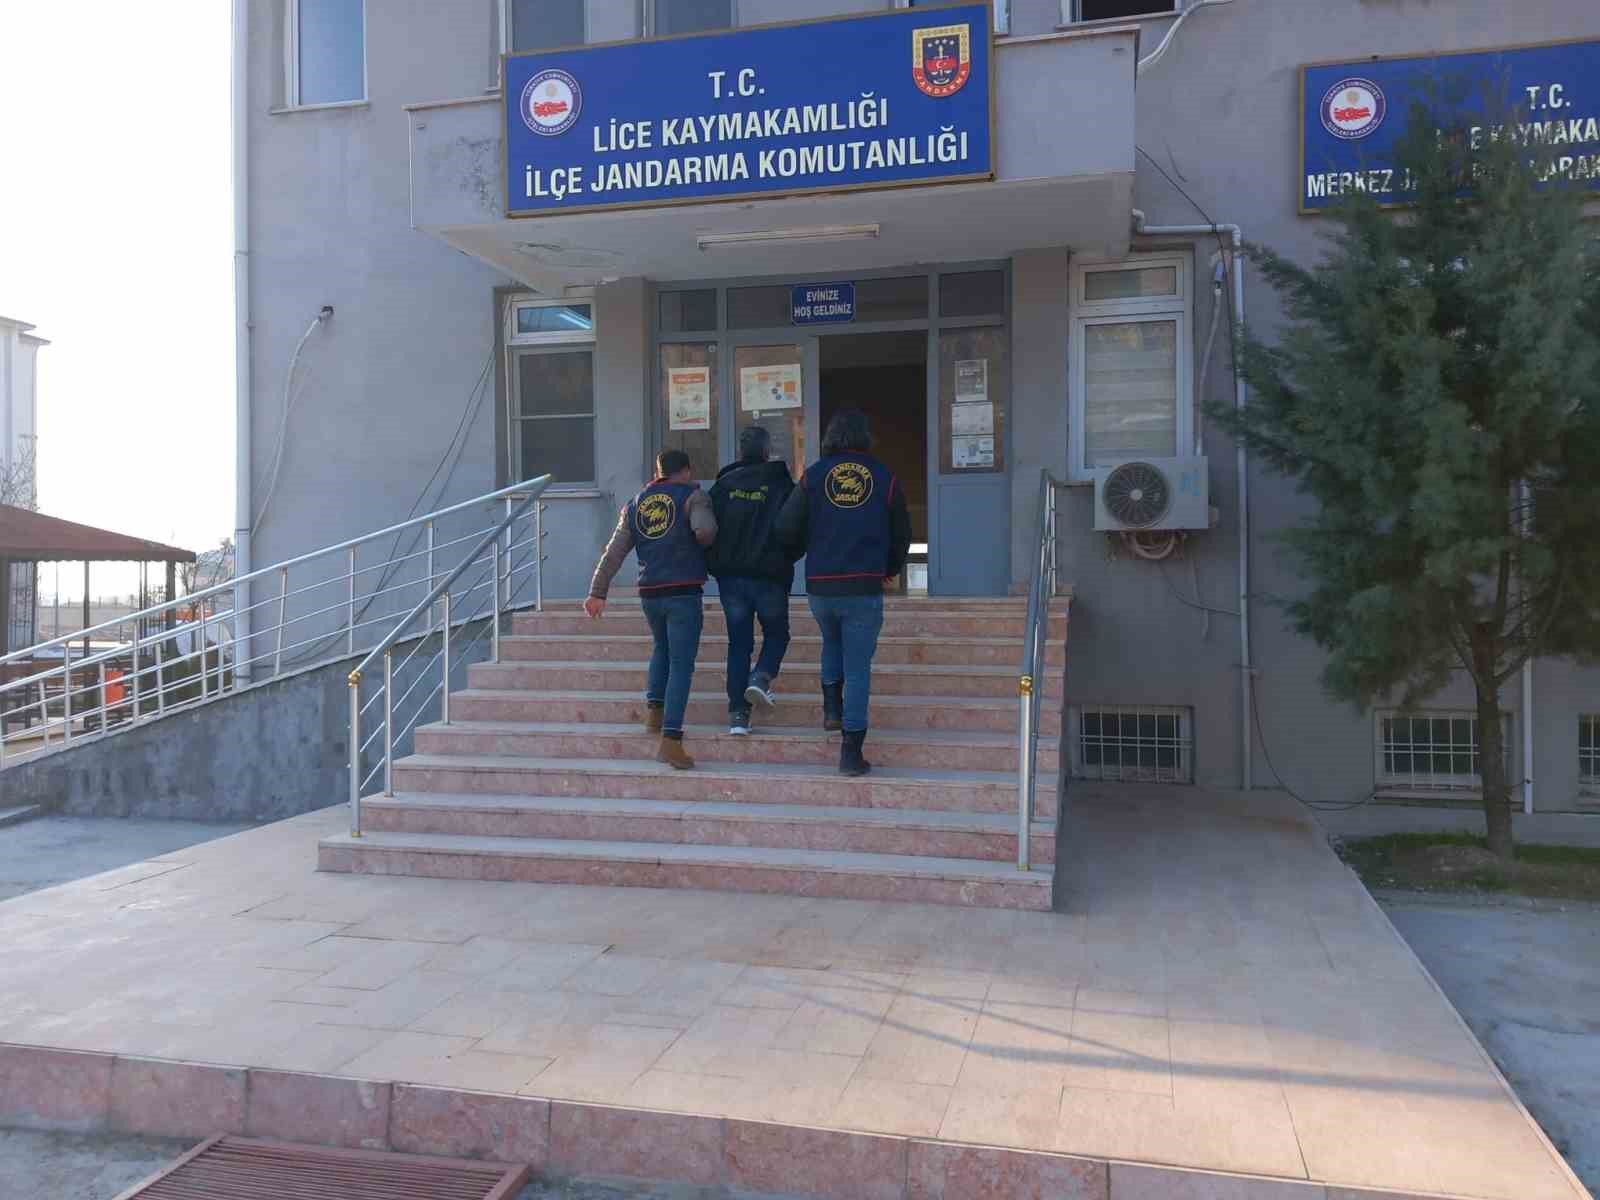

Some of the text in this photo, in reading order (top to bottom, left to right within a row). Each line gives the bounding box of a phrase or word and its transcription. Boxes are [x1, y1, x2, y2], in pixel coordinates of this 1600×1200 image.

[708, 68, 765, 98] T.C.
[1526, 83, 1571, 110] T.C.
[593, 91, 888, 152] LİCE KAYMAKAMLIĞI
[525, 125, 968, 201] İLÇE JANDARMA KOMUTANLIĞI
[1308, 169, 1393, 197] MERKEZ
